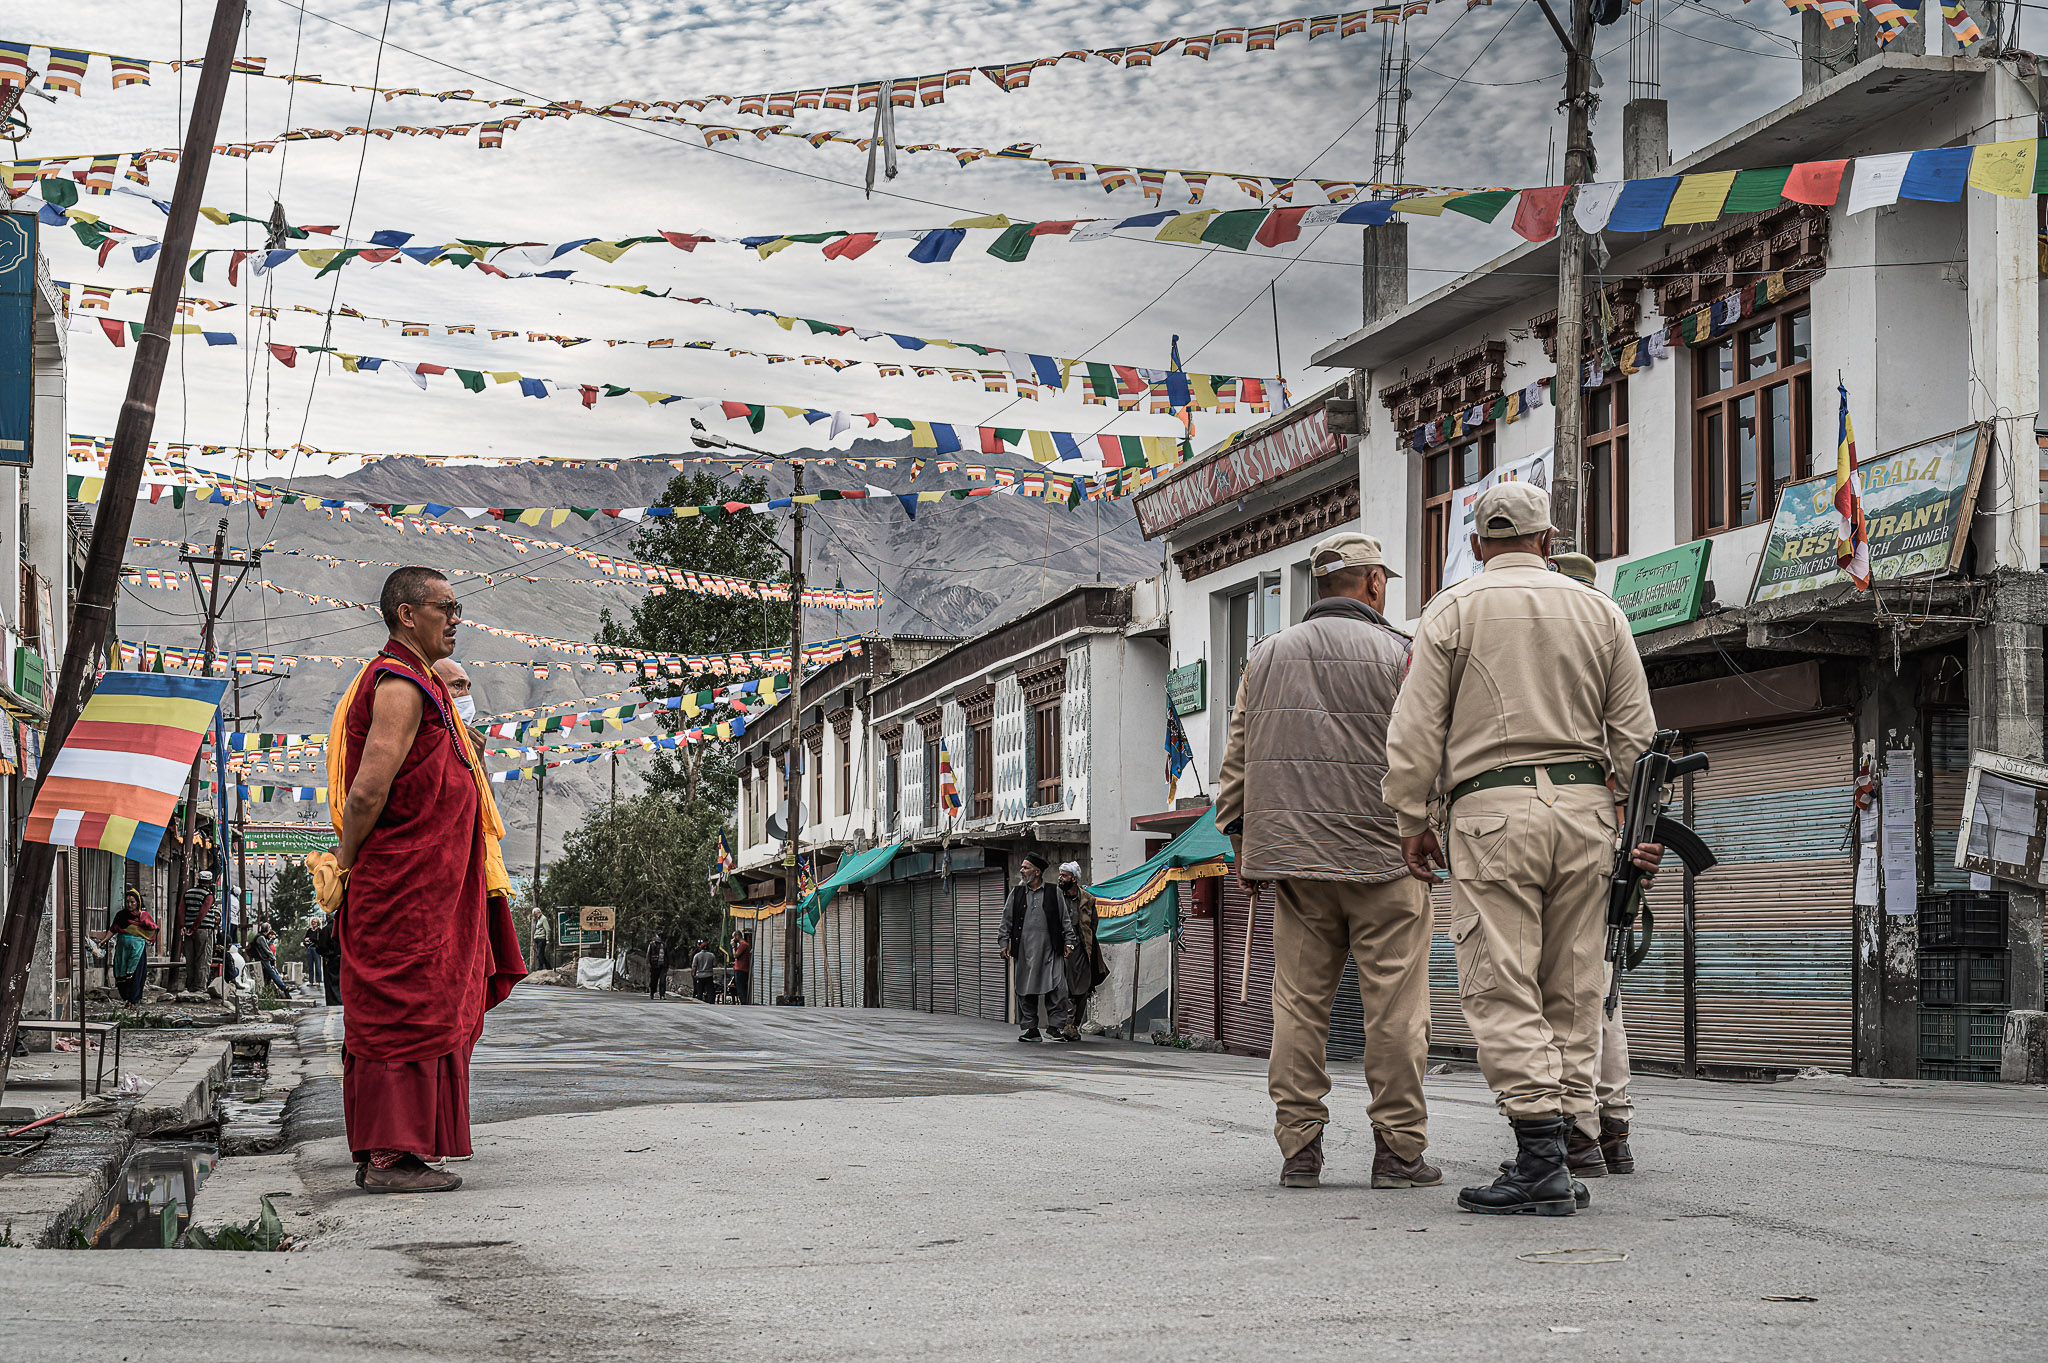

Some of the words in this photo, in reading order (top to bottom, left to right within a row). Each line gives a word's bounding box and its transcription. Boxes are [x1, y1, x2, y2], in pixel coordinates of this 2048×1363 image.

[1229, 408, 1328, 486] RESTAURANT
[1813, 457, 1941, 514] CRALA
[1772, 555, 1838, 580] BREAKFAST
[1994, 757, 2034, 776] NOTICE
